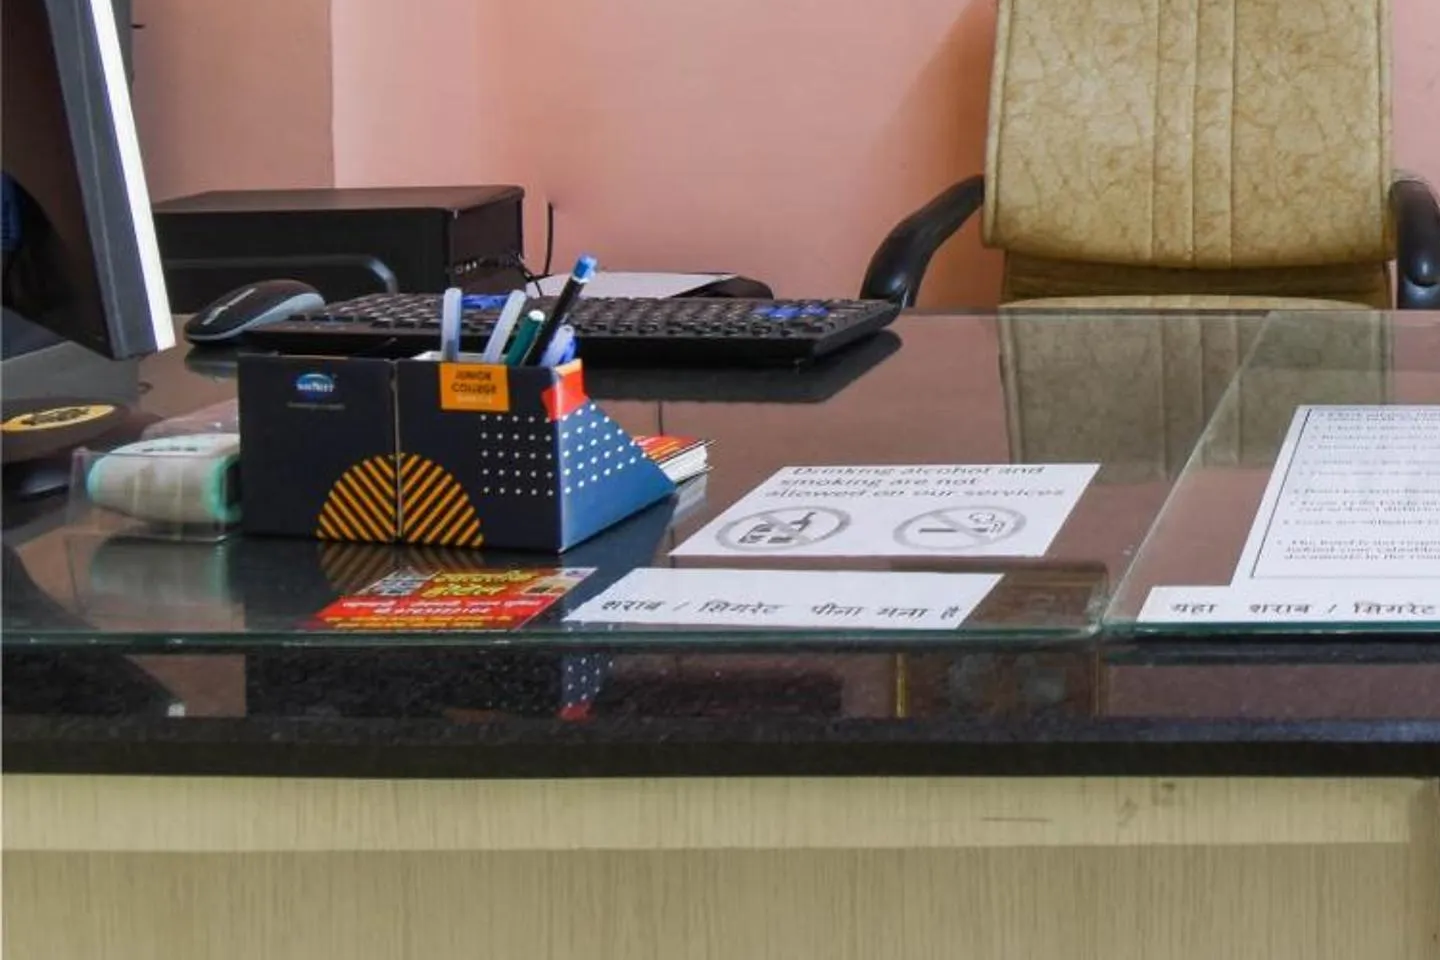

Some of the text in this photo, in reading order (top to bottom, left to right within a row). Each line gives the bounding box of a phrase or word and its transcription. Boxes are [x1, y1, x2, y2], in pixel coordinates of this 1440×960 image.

[900, 466, 990, 475] alcohol
[998, 465, 1046, 475] and
[781, 478, 883, 488] smoking
[936, 477, 979, 486] not
[765, 488, 867, 498] allowed
[876, 604, 930, 619] मना
[940, 603, 963, 620] है
